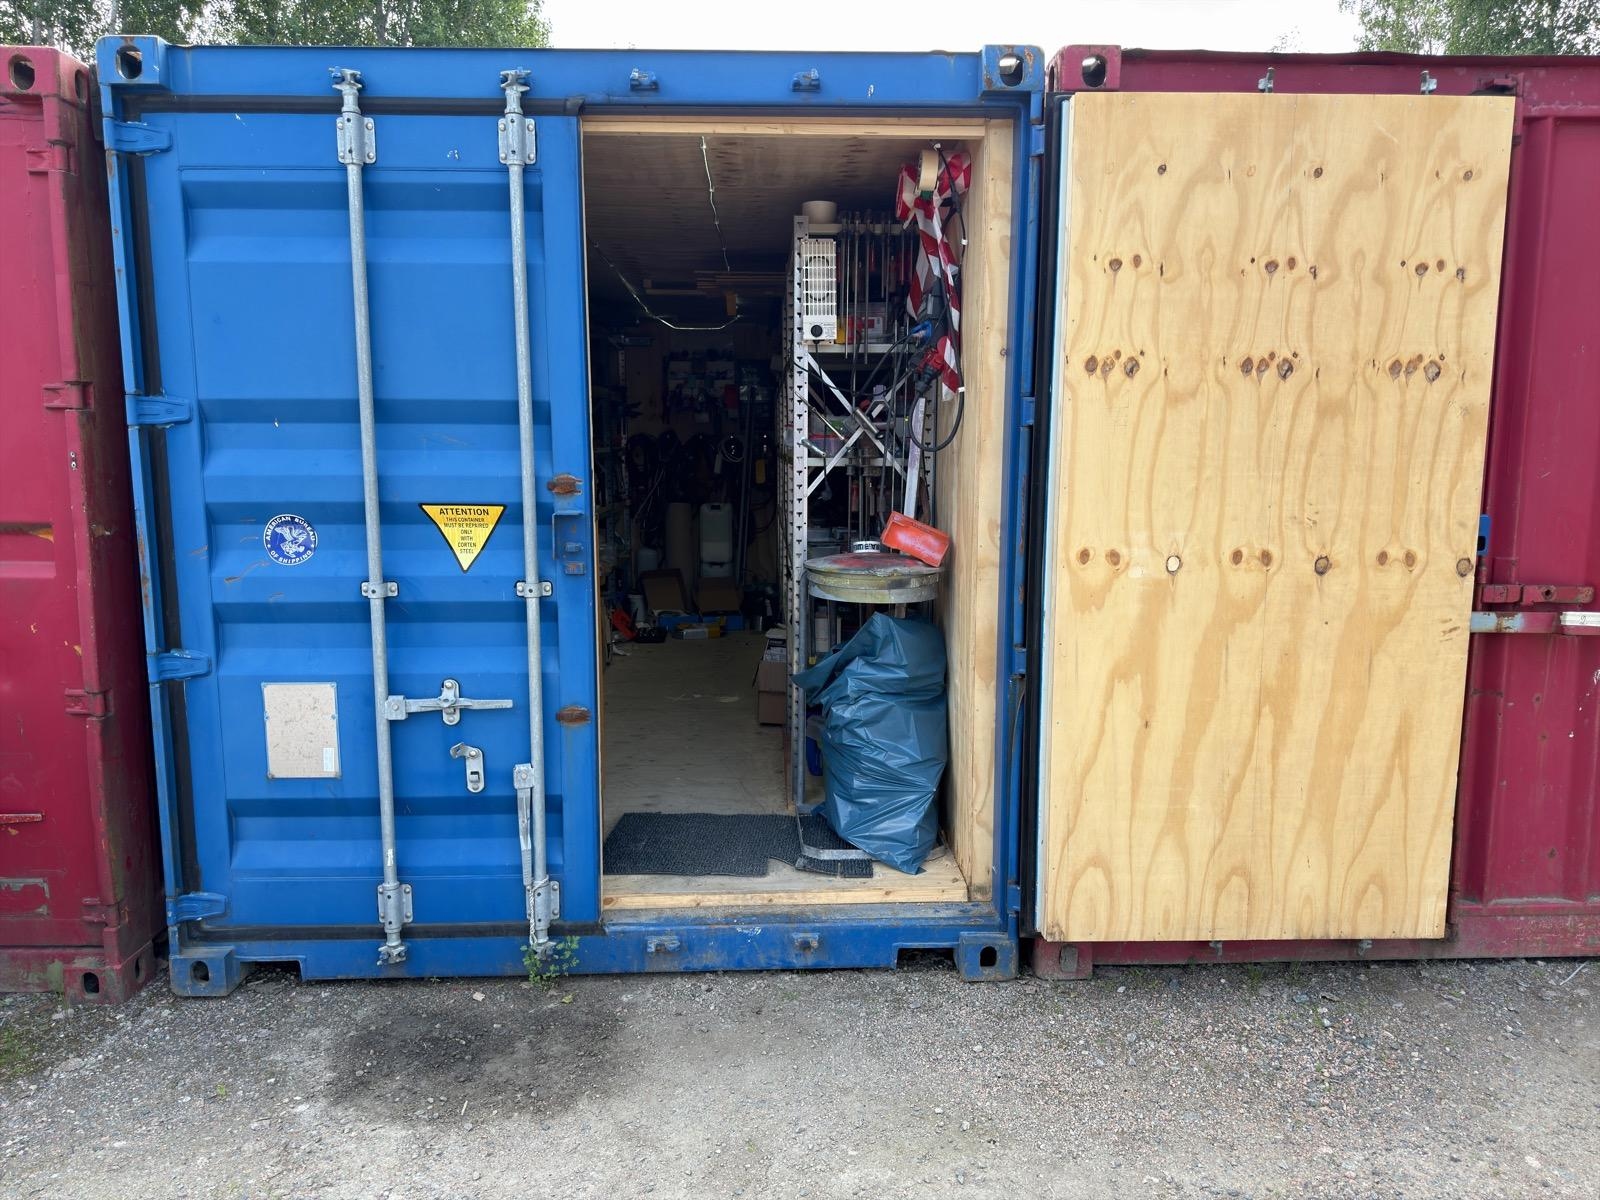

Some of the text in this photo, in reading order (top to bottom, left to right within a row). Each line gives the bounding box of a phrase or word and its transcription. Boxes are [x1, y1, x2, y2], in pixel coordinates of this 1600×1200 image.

[265, 516, 316, 541] AMERICAN BUREAU
[270, 550, 312, 564] OF SHIPPING
